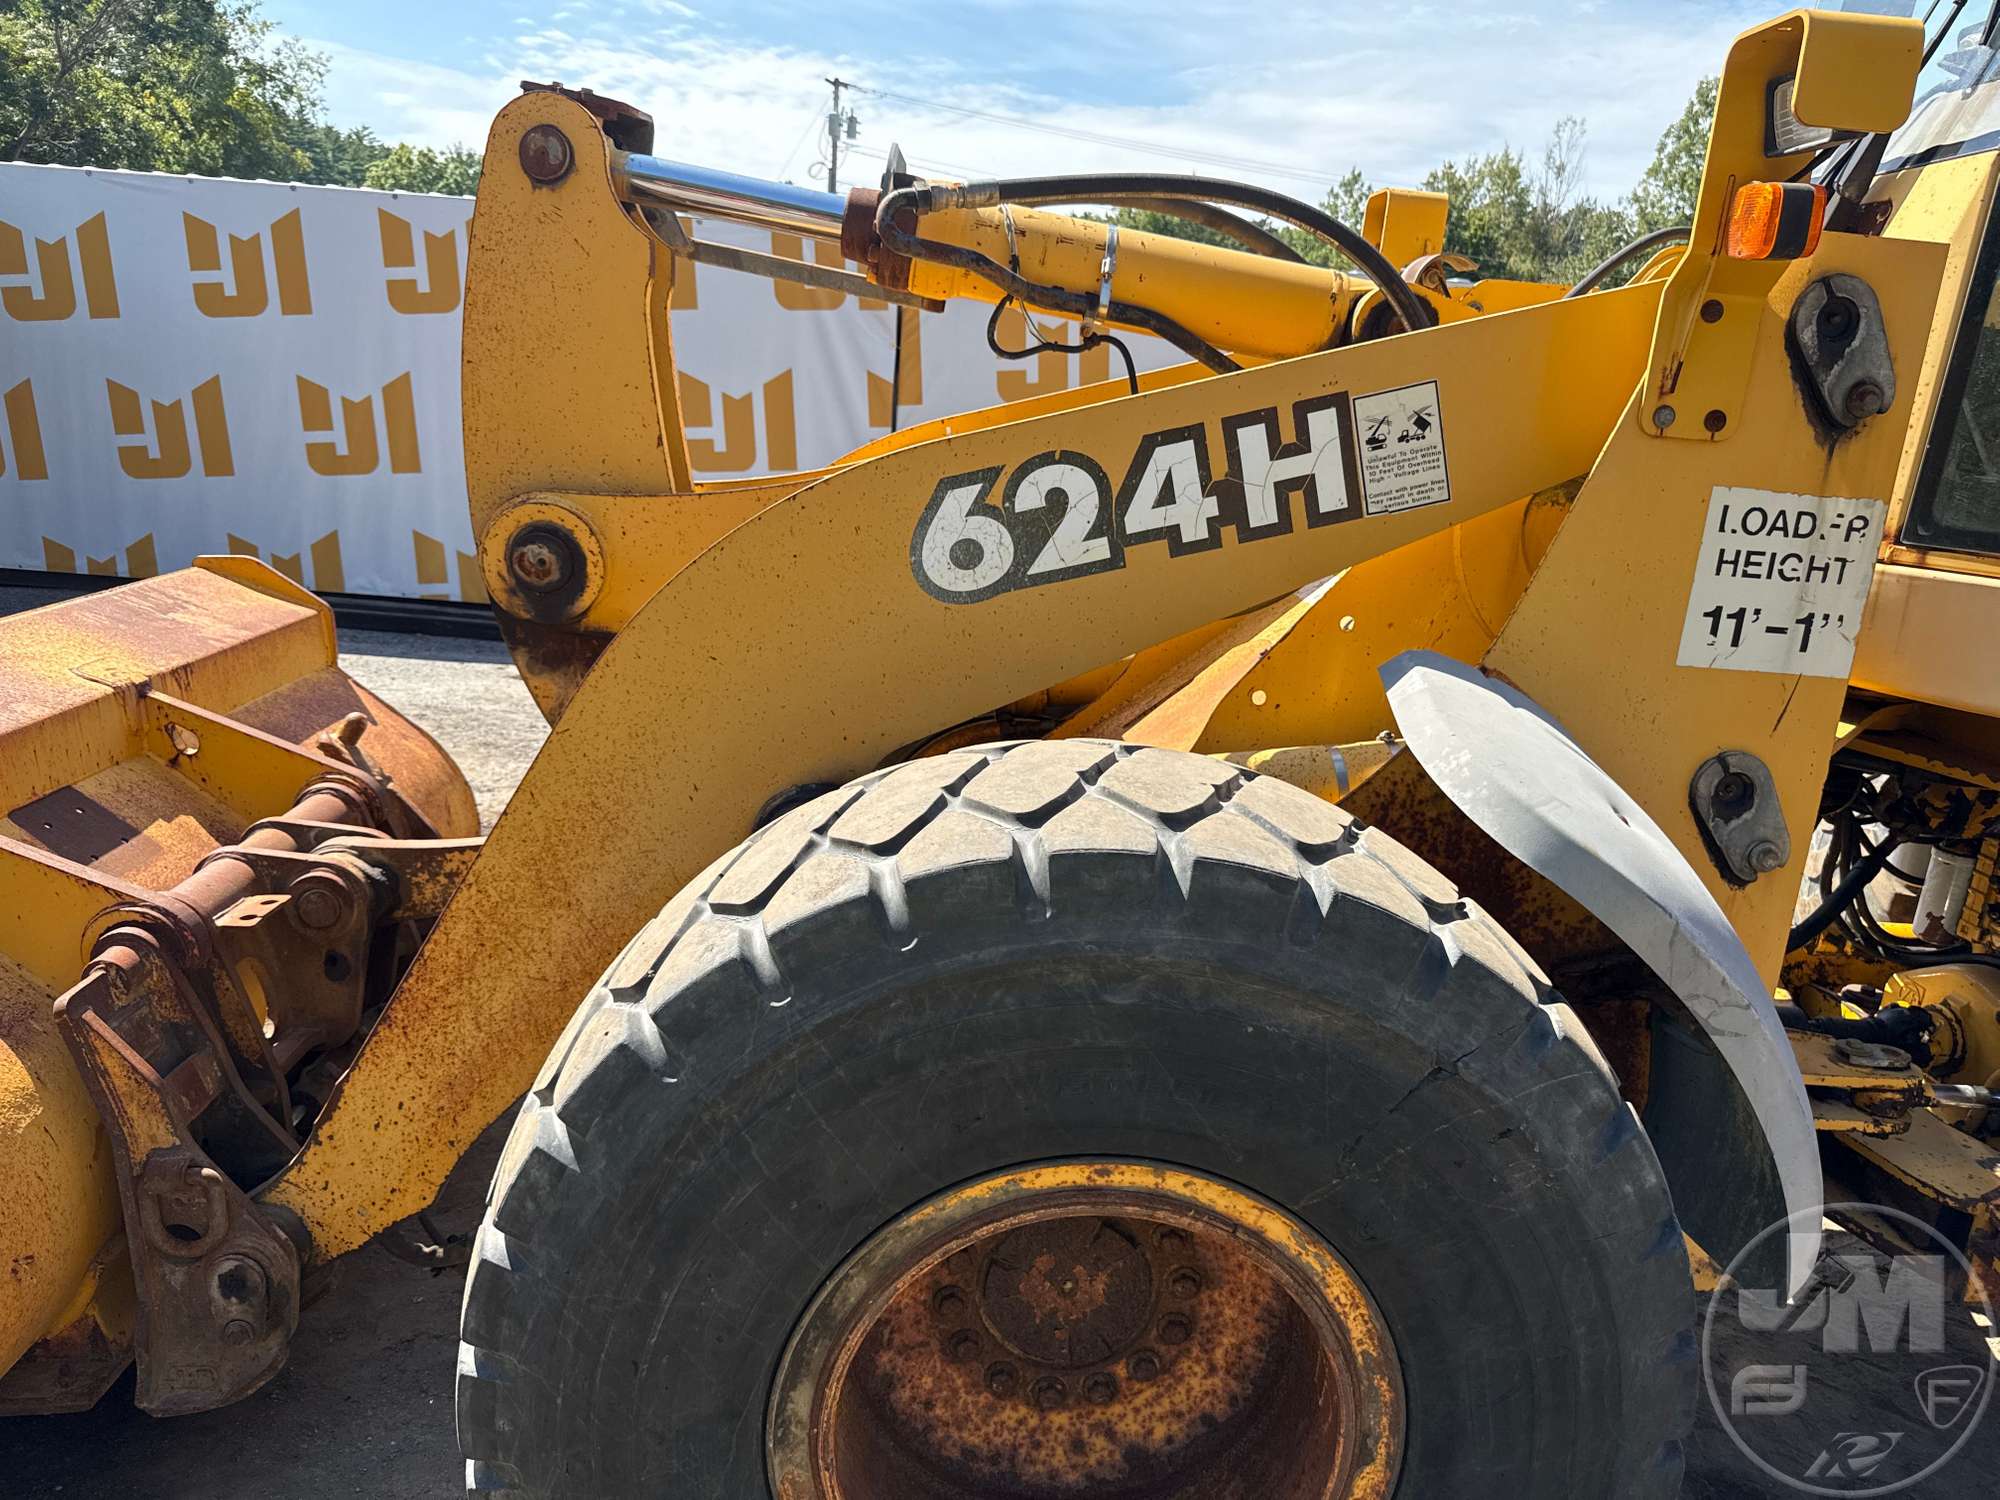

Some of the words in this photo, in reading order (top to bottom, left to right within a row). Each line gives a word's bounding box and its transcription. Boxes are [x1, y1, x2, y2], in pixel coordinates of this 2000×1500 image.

[1368, 453, 1396, 464] Unlawful
[1410, 446, 1437, 454] Operate
[1382, 456, 1418, 467] Equipment
[1408, 458, 1440, 468] Overhead
[1394, 469, 1419, 478] Voltage
[920, 406, 1348, 592] 624H
[1369, 490, 1392, 499] Contact
[1410, 482, 1428, 491] power
[1714, 548, 1854, 584] HEIGHT
